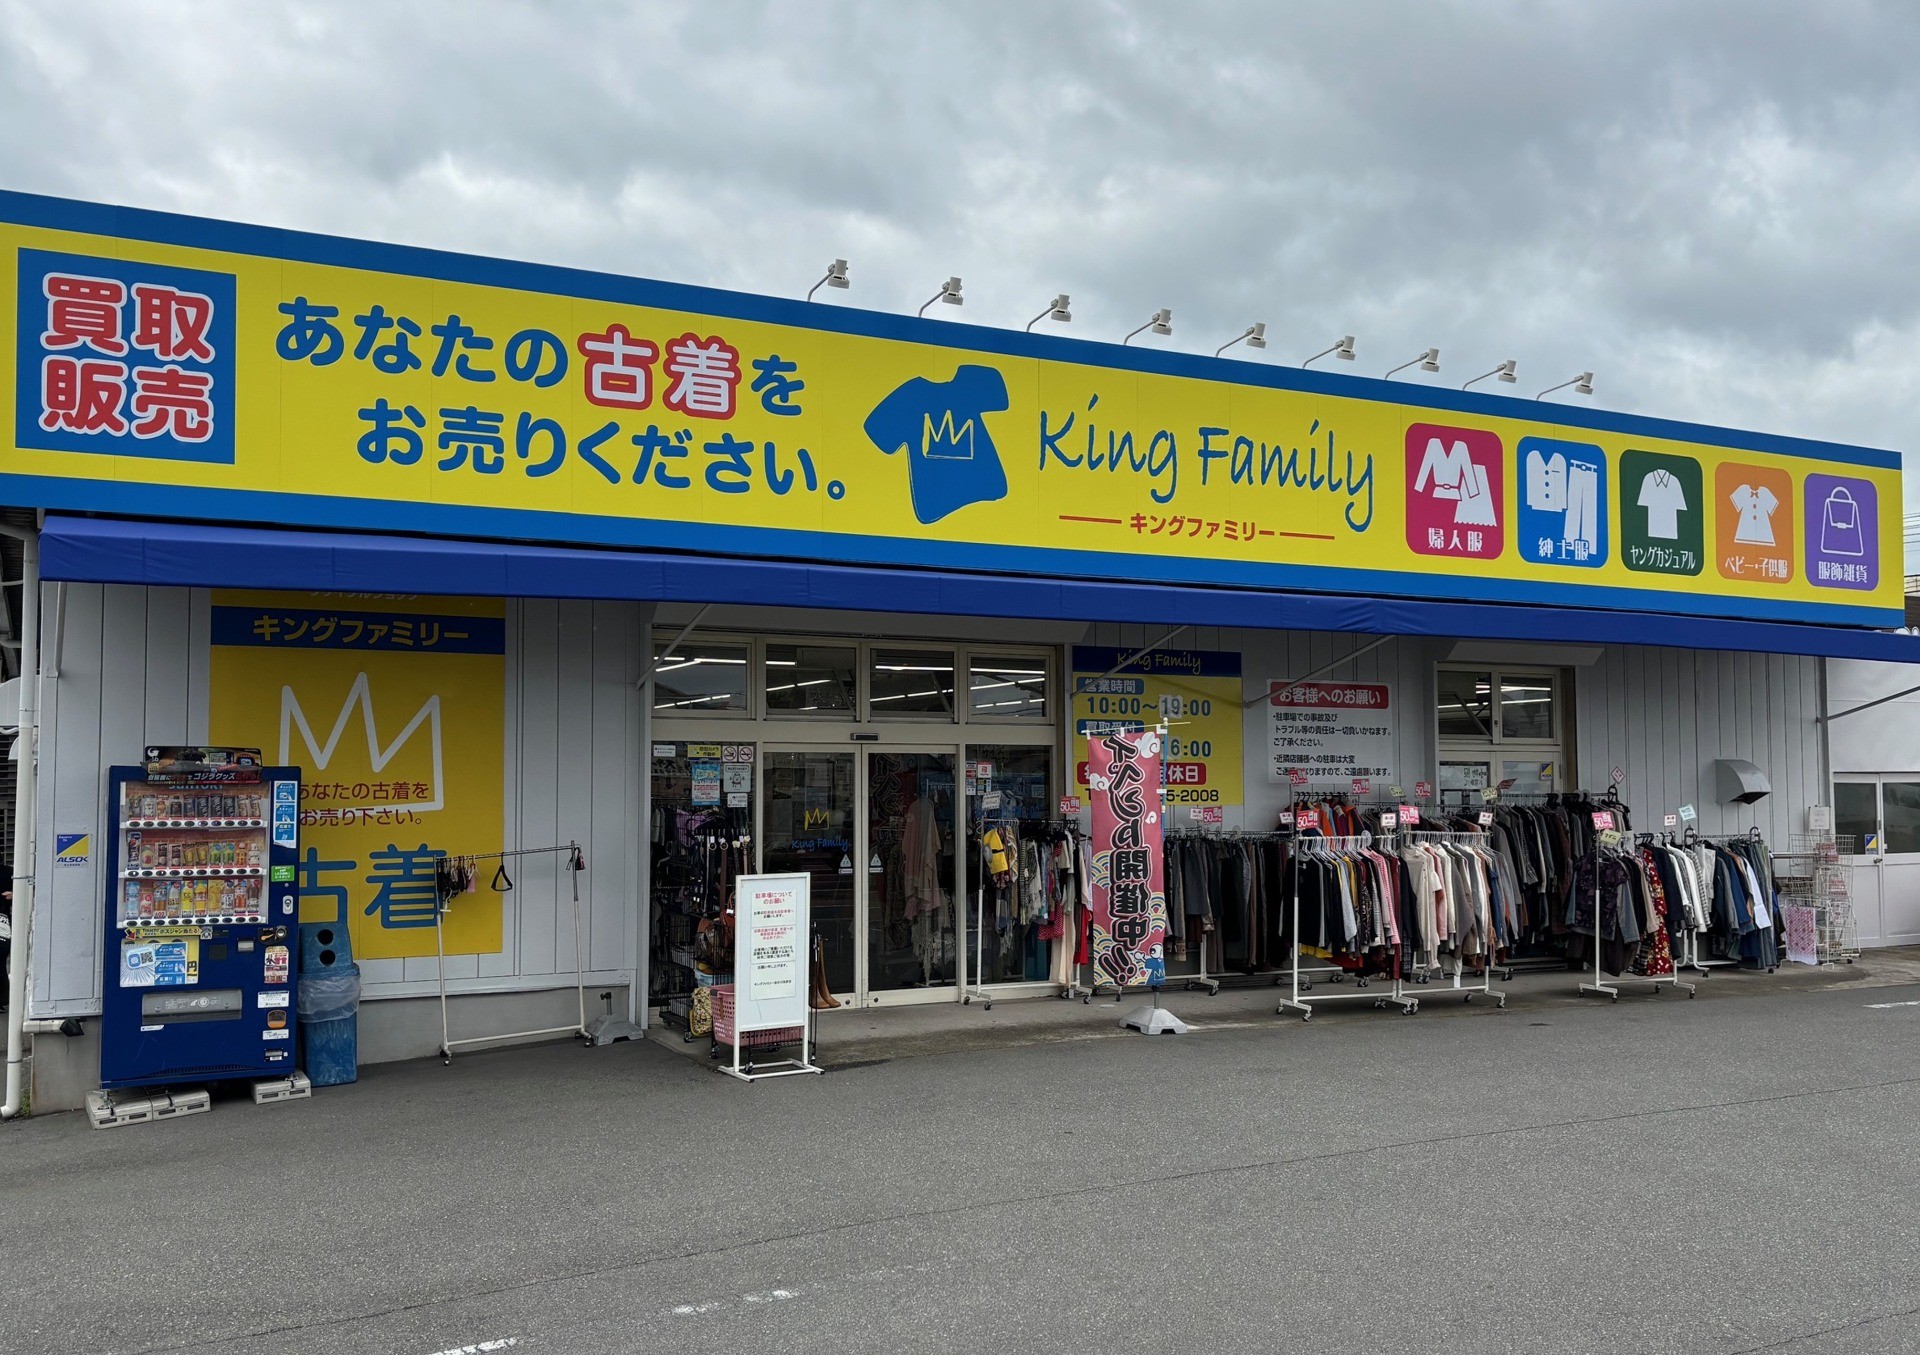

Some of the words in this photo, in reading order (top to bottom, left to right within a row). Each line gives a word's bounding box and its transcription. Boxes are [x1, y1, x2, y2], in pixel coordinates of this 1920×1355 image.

[43, 272, 213, 362] 買取
[275, 296, 804, 420] あなたの古着を
[41, 356, 213, 442] 販売
[357, 397, 846, 501] お売りください。
[1039, 393, 1177, 503] King
[1198, 419, 1373, 532] Family
[1130, 512, 1275, 541] キングファミリー
[1428, 527, 1483, 552] 婦人服
[1538, 537, 1590, 561] 紳士服
[1630, 545, 1696, 570] ヤングカジュアル
[1725, 556, 1788, 578] ベビー・子供服
[1818, 561, 1868, 583] 服飾雑貨
[253, 615, 469, 646] キングファミリー
[1155, 652, 1202, 675] Family
[1085, 678, 1136, 694] 営業時間
[1280, 687, 1380, 704] お客様へのお願い
[1274, 738, 1324, 747] ご了承ください。
[300, 808, 422, 826] お売り下さい。
